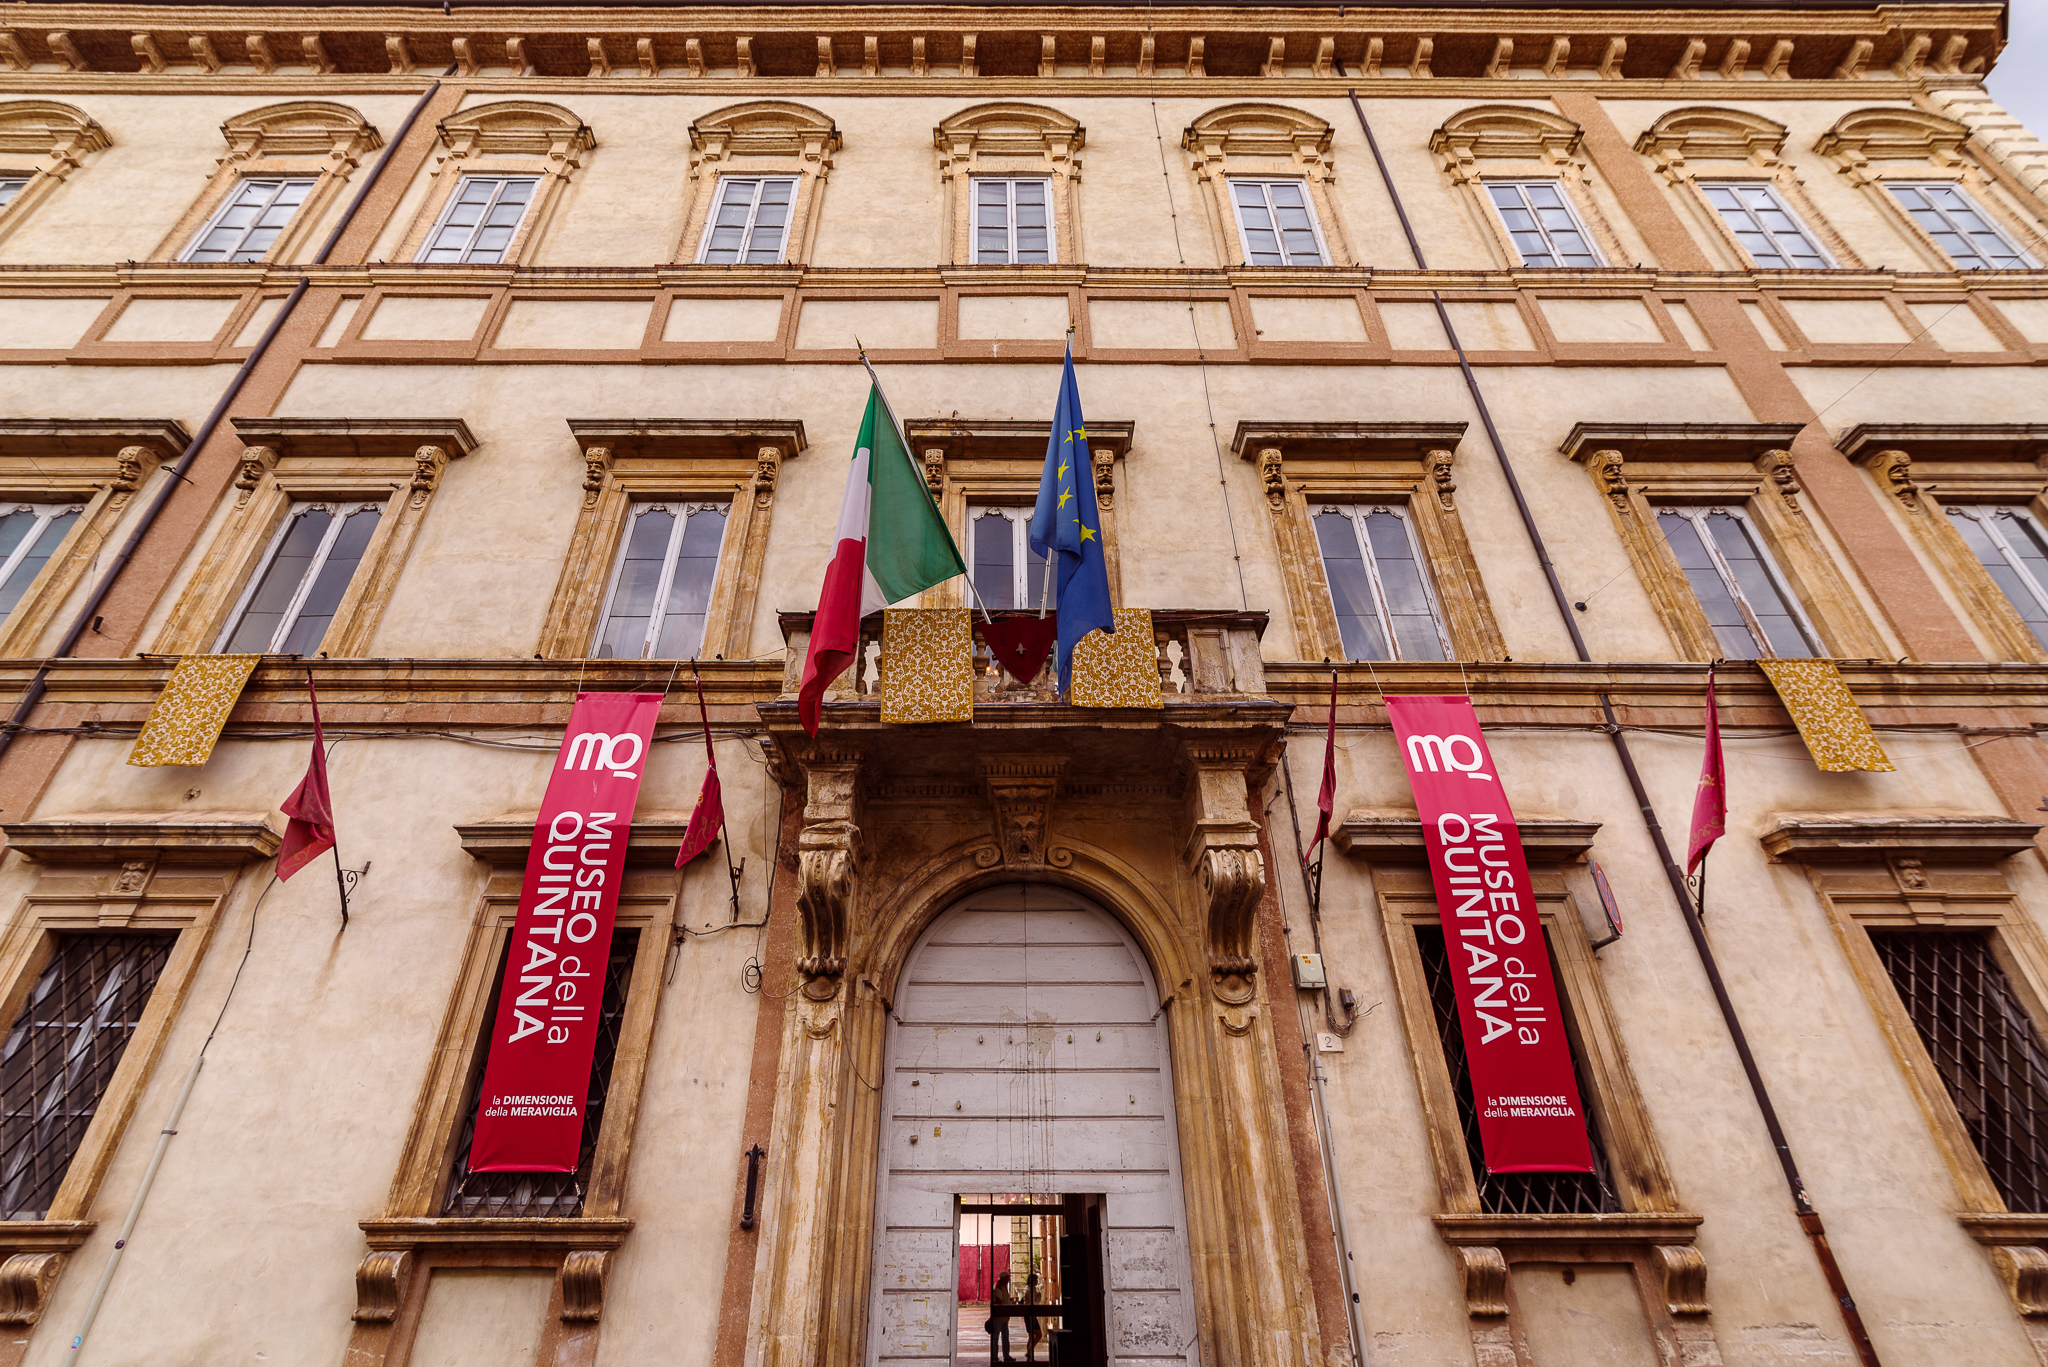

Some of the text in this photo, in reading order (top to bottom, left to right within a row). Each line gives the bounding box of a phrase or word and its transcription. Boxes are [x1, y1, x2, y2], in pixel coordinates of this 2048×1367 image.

[508, 811, 584, 1044] QUINTANA
[547, 812, 617, 1044] MUSEO della
[1437, 812, 1513, 1045] QUINTANA
[1470, 813, 1547, 1045] MUSEO della
[1324, 1036, 1333, 1048] 2
[492, 1095, 573, 1105] la DIMENSIONE
[1487, 1095, 1568, 1106] la DIMENSIONE
[485, 1106, 578, 1117] della MERAVIGLIA
[1483, 1106, 1576, 1118] della MERAVIGLIA
